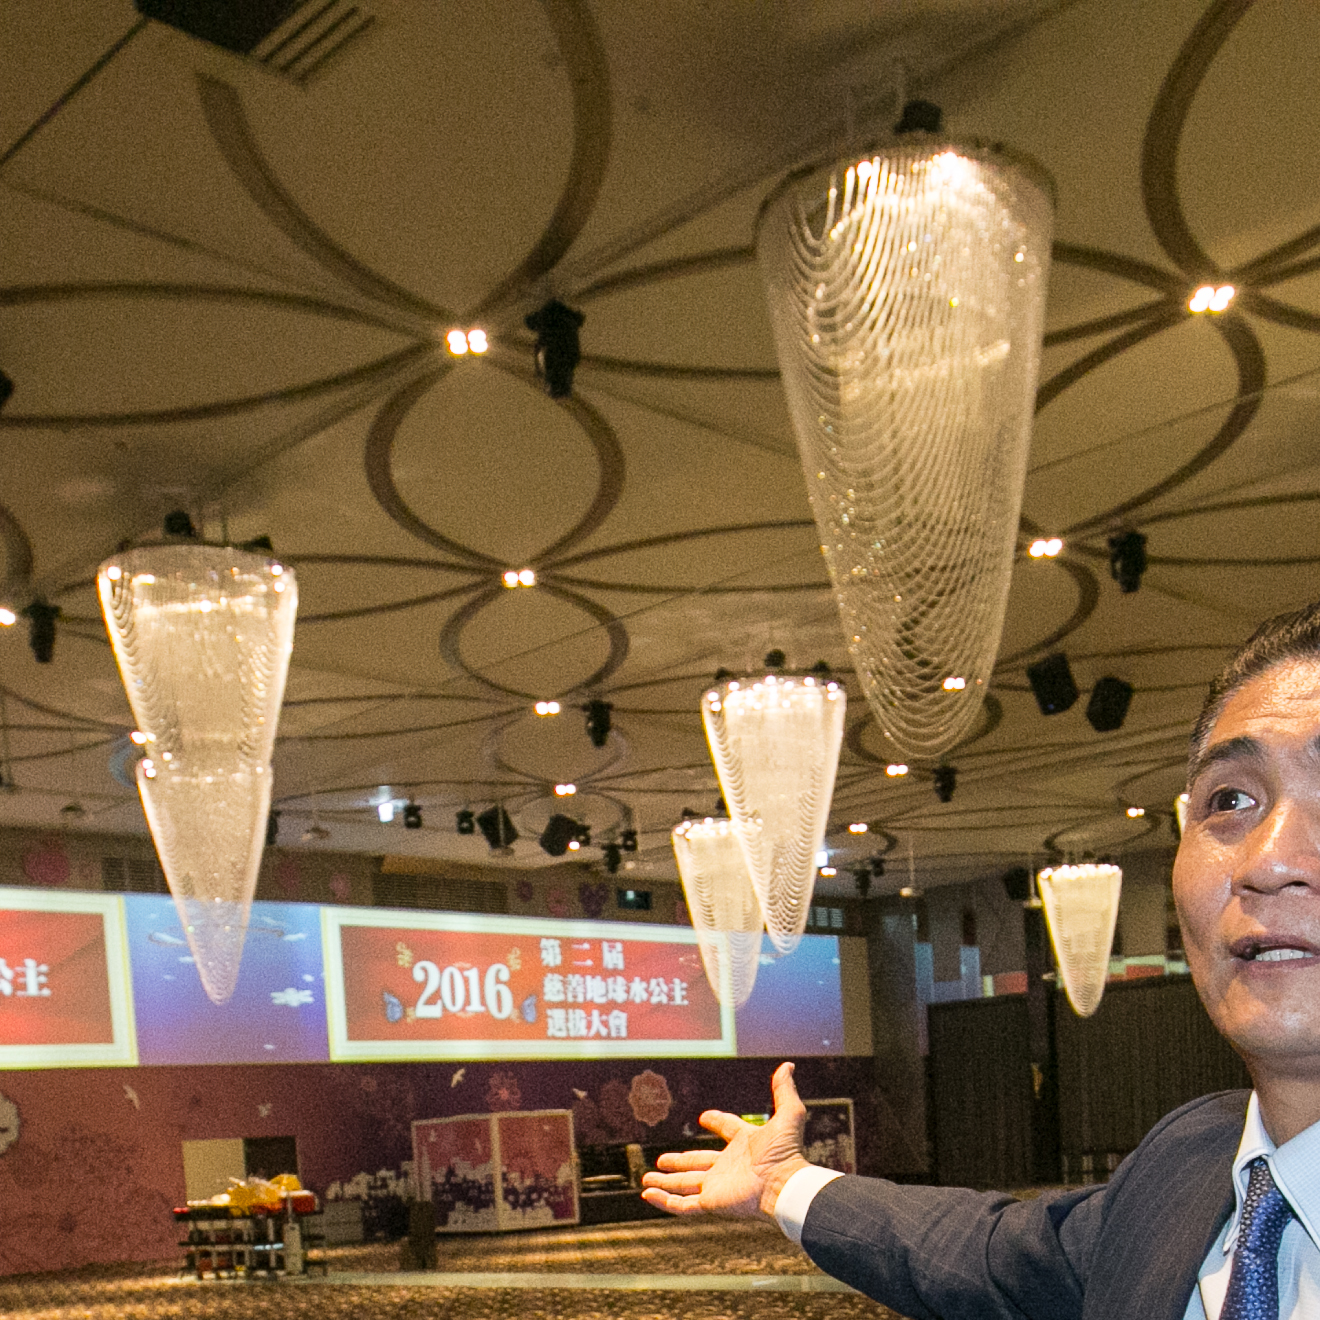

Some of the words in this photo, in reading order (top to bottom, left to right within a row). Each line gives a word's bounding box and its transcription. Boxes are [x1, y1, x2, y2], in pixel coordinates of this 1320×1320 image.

[413, 961, 513, 1019] 2016
[543, 973, 688, 1005] 慈善地球水公主
[546, 1008, 628, 1037] 選拔大會
